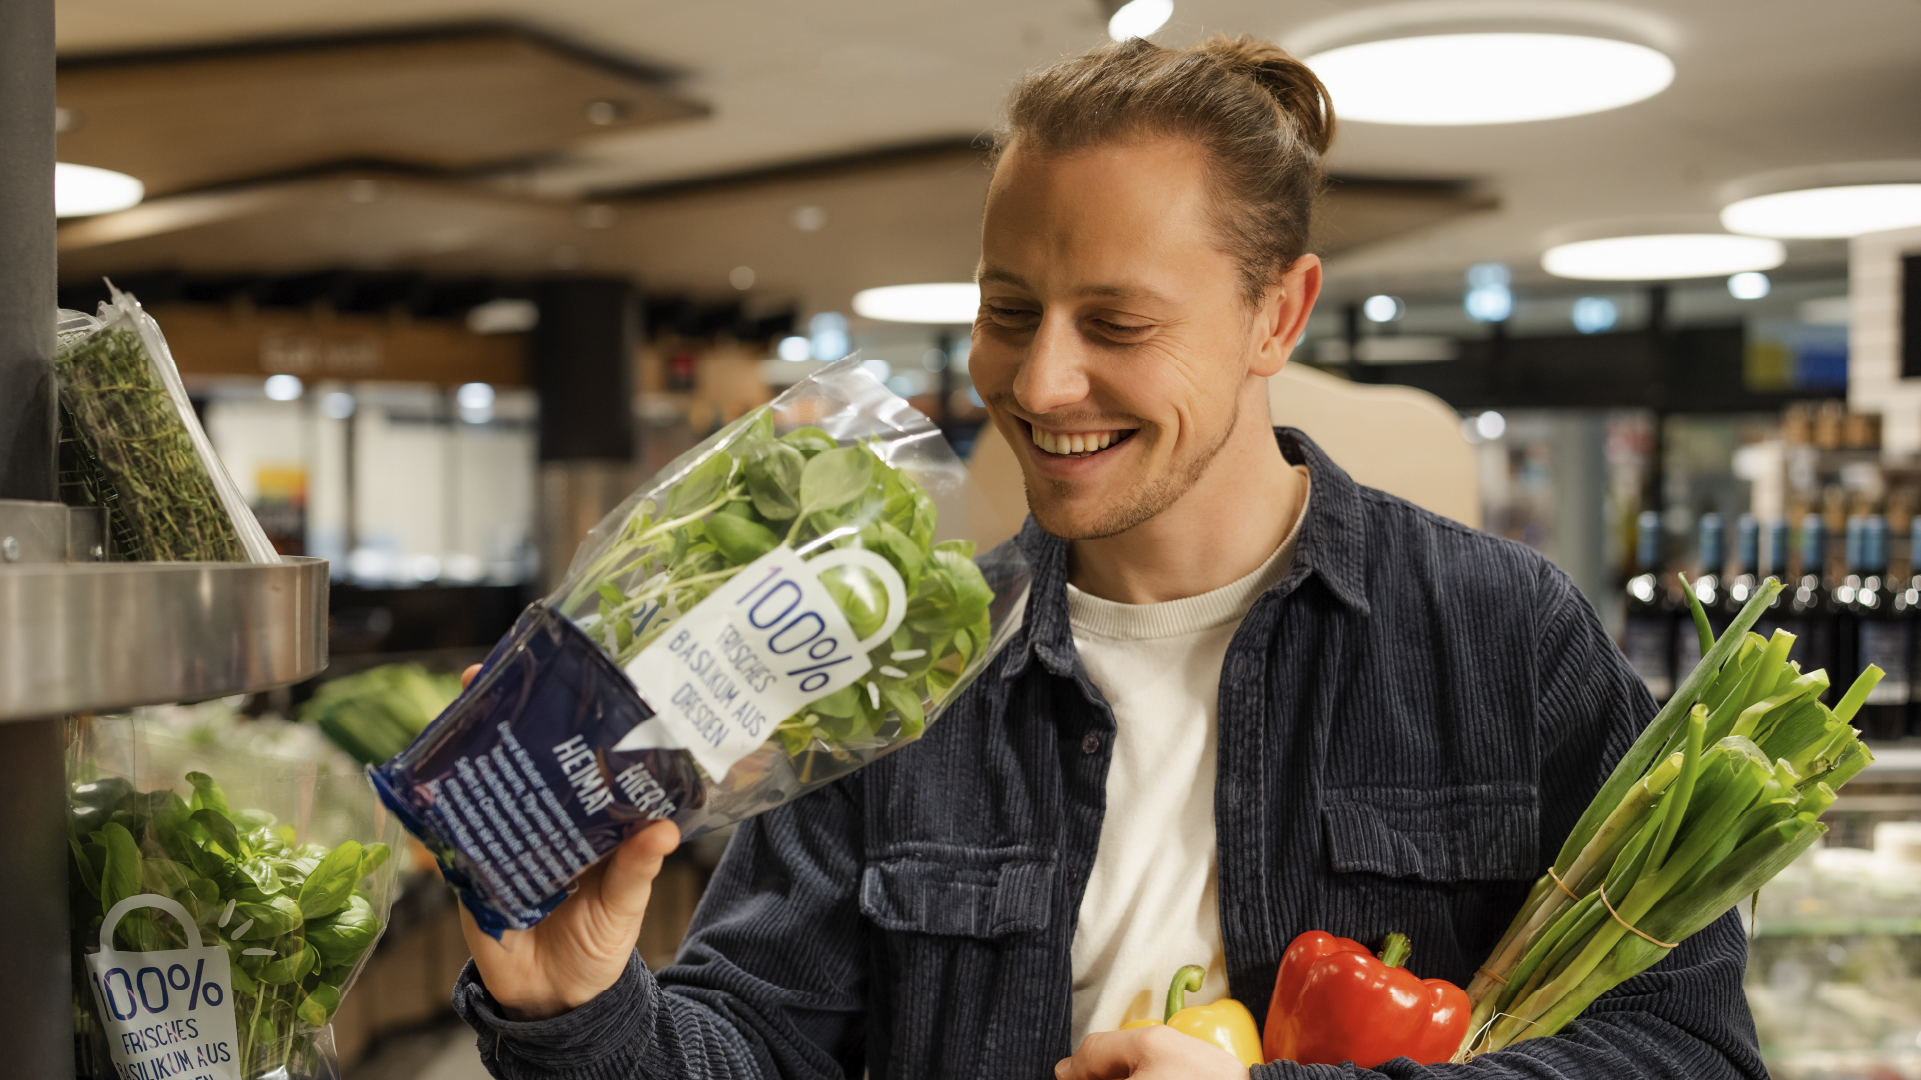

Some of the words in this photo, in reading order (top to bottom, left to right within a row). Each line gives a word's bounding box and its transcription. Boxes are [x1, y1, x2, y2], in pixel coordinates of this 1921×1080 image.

[715, 624, 777, 694] FRISCHES
[736, 567, 853, 693] 100%
[668, 629, 741, 710] BASILIKUM
[732, 700, 767, 739] AUS
[552, 734, 616, 816] HEIMAT
[615, 762, 666, 812] HIER
[93, 958, 224, 1023] 100%
[121, 1018, 199, 1055] FRISCHES
[197, 1041, 231, 1068] AUS
